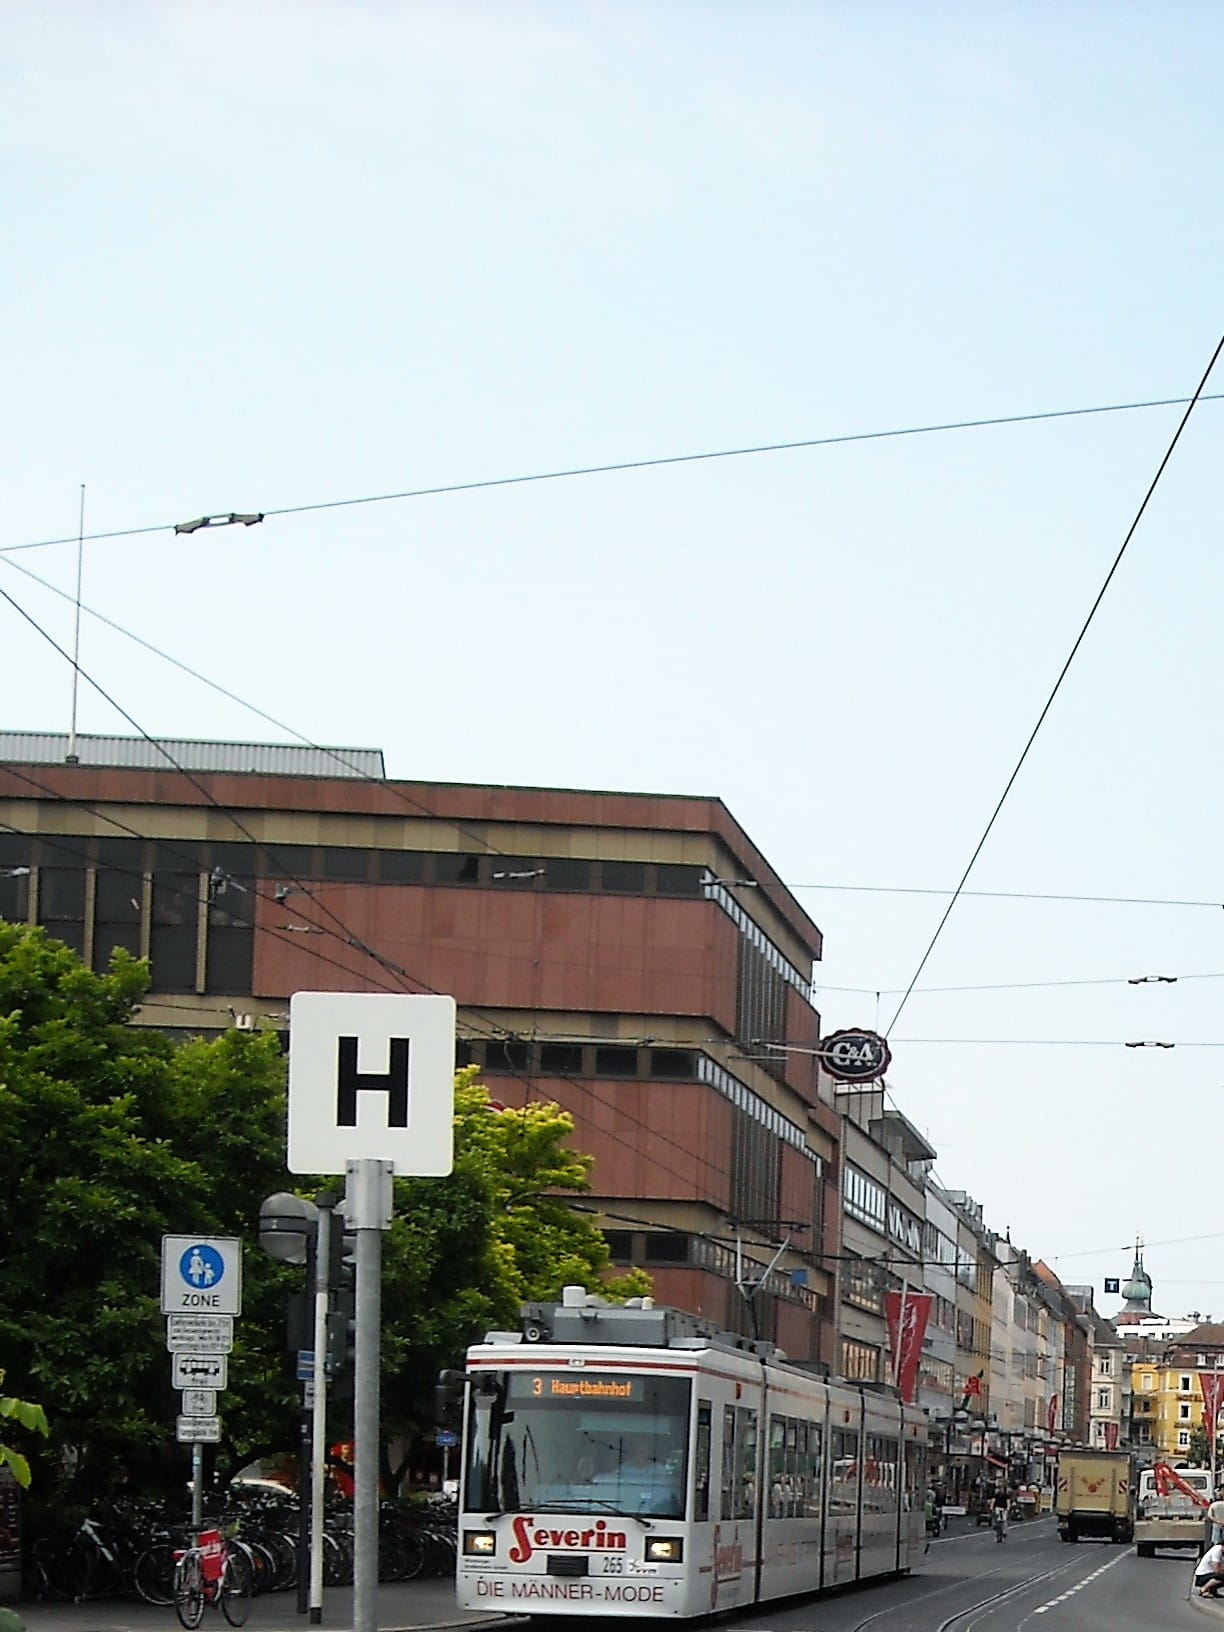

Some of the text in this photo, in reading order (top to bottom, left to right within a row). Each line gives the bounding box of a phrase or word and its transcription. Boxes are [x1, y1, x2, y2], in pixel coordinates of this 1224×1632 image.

[833, 1042, 875, 1066] C&A
[336, 1036, 410, 1128] H
[182, 1294, 220, 1307] ZONE
[532, 1378, 632, 1398] 3 Hauptbahnhof
[508, 1516, 626, 1563] Severin
[603, 1557, 622, 1574] 265
[477, 1581, 504, 1597] DIE
